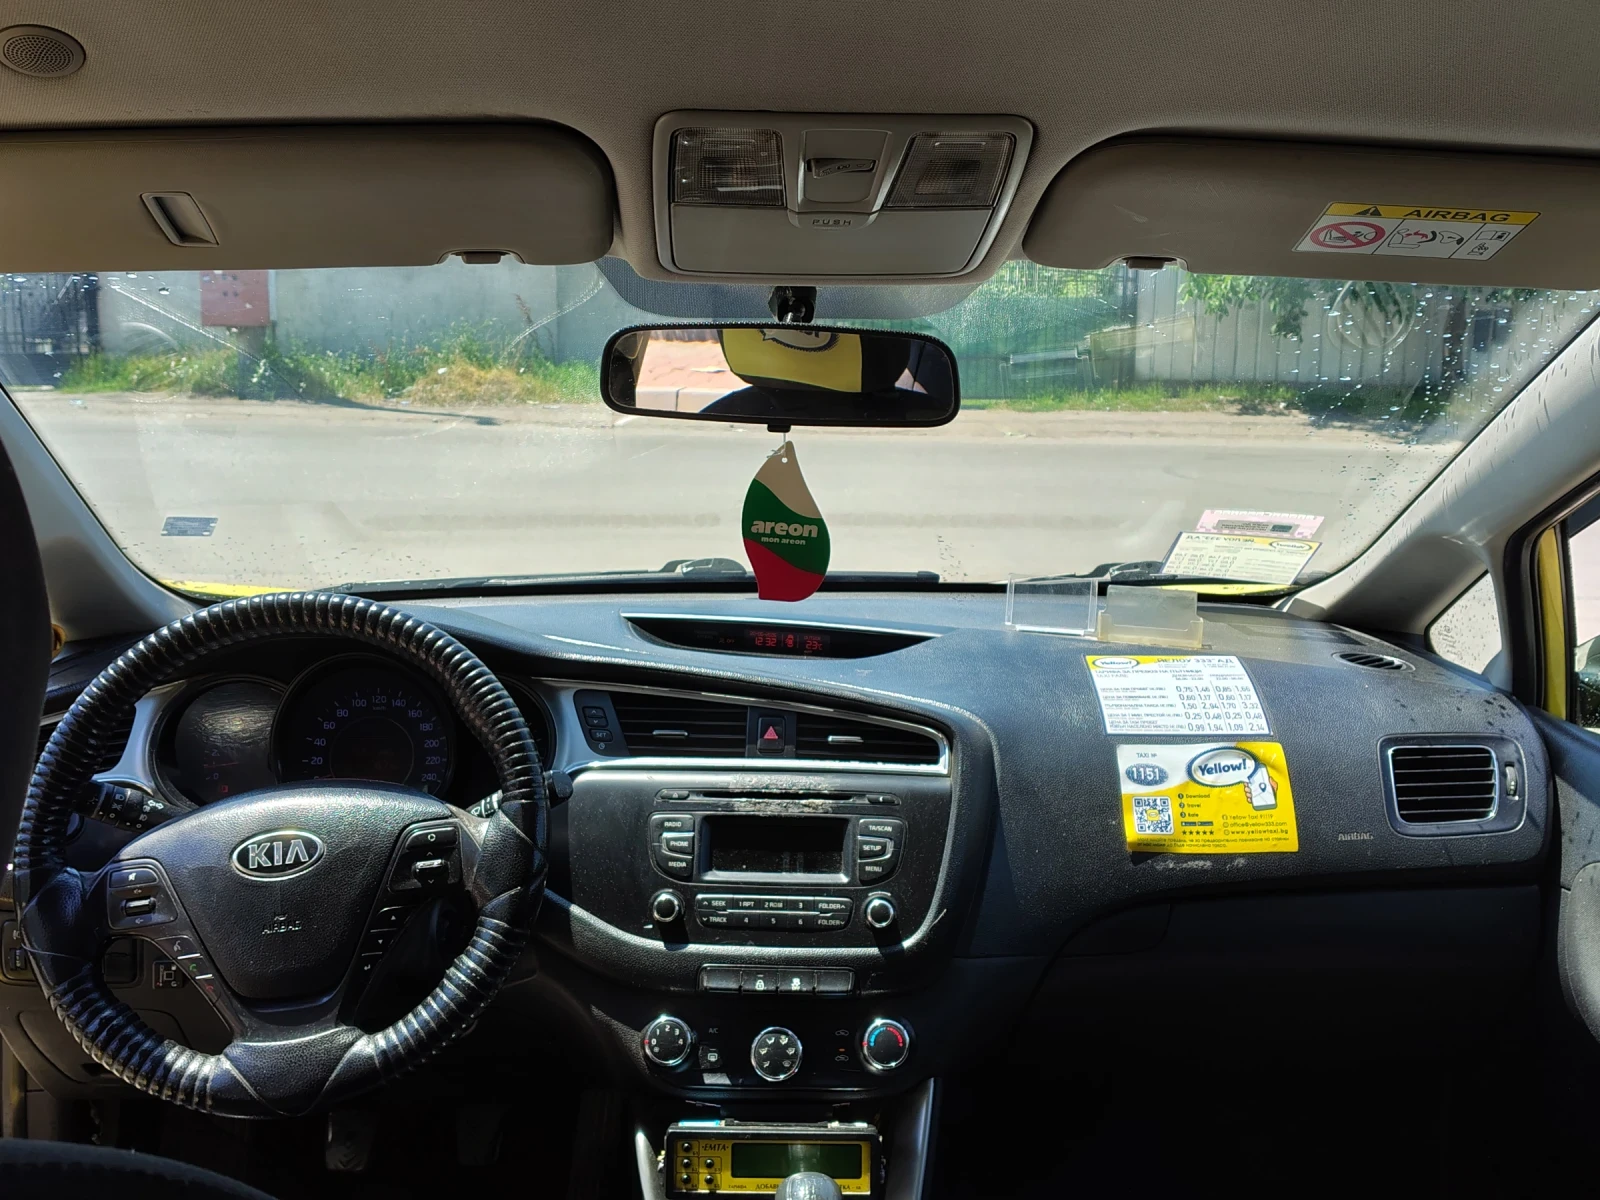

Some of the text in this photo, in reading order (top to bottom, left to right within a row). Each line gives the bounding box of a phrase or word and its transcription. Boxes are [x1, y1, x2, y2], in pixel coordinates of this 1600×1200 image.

[1403, 208, 1511, 222] AIRBAG
[750, 520, 819, 538] areon
[352, 699, 367, 708] 100
[372, 695, 387, 704] 120
[391, 699, 406, 708] 140
[336, 709, 348, 718] 80
[408, 709, 422, 718] 160
[324, 722, 336, 730] 60
[420, 722, 434, 732] 180
[314, 738, 326, 746] 40
[424, 739, 440, 748] 200
[310, 756, 323, 765] 20
[425, 756, 441, 764] 220
[1198, 758, 1247, 776] Yellow!
[421, 773, 437, 782] 240
[1132, 767, 1160, 780] 1151
[248, 839, 309, 869] KIA
